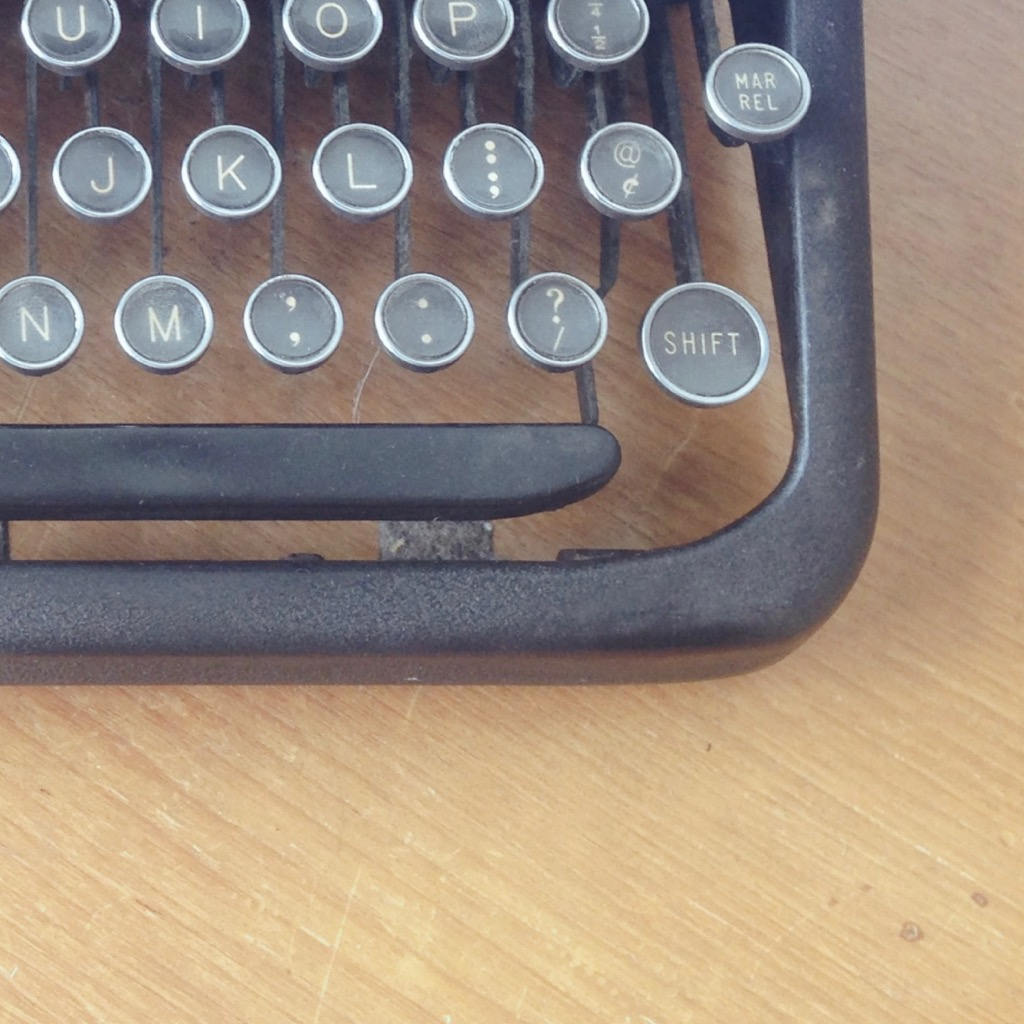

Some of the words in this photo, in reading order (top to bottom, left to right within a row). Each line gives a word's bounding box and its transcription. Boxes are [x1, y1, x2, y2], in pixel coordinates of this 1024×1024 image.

[56, 4, 86, 42] U
[196, 4, 204, 41] I
[315, 2, 348, 39] O
[448, 1, 477, 37] P
[734, 71, 777, 90] MAR
[738, 93, 779, 112] REL
[217, 154, 247, 191] K
[346, 152, 378, 190] L
[613, 139, 642, 169] @
[90, 156, 115, 194] J
[19, 304, 51, 343] N
[147, 304, 182, 343] M
[545, 287, 565, 325] ?
[663, 330, 740, 356] SHIFT
